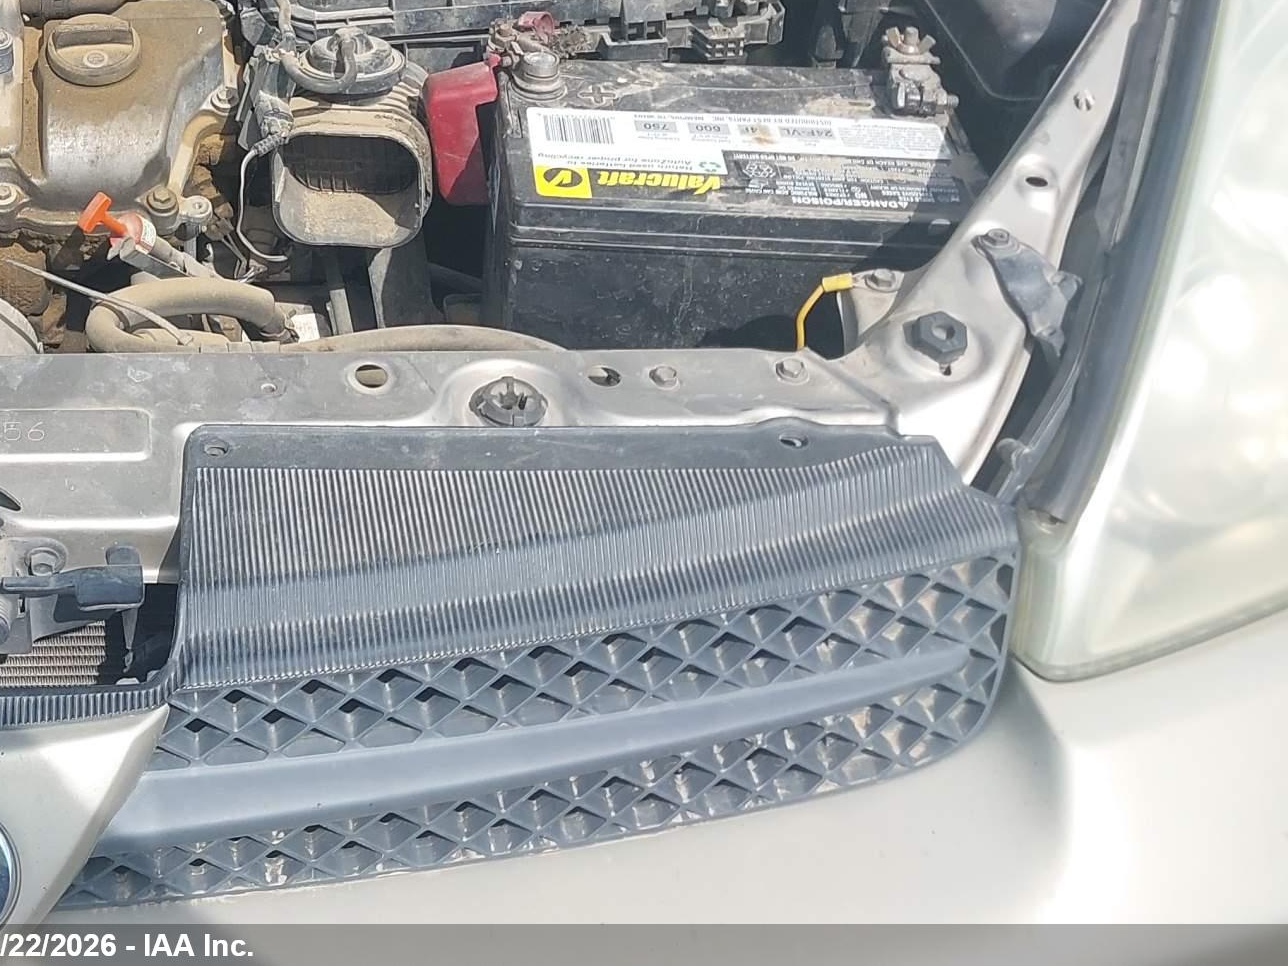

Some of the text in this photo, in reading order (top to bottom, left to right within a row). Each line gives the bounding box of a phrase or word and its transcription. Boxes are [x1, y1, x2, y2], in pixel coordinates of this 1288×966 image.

[643, 123, 669, 131] 750
[695, 124, 721, 133] 600
[597, 170, 721, 195] Valucraft
